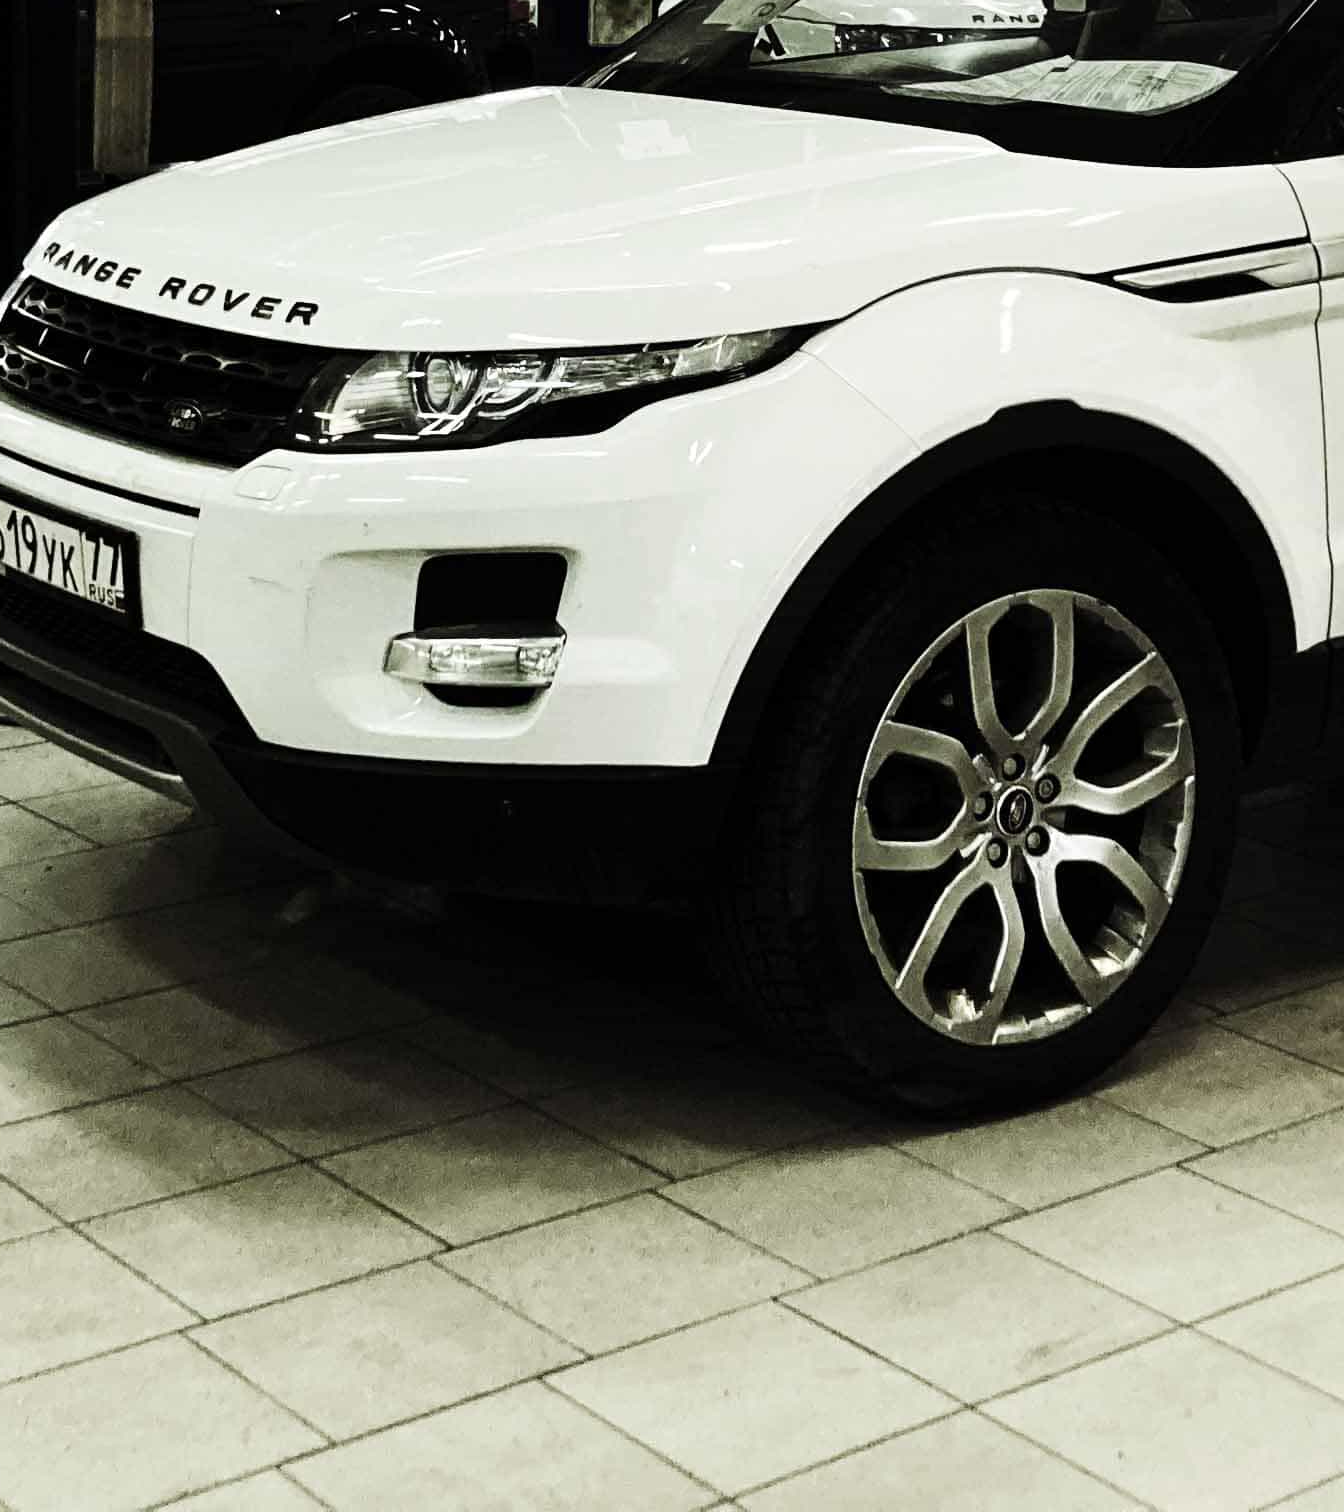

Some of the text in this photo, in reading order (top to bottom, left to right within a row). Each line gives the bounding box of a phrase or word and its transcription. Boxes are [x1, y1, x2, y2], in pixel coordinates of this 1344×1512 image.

[971, 14, 1040, 24] RANG
[43, 241, 319, 326] RANGE ROVER
[88, 583, 115, 607] RUS
